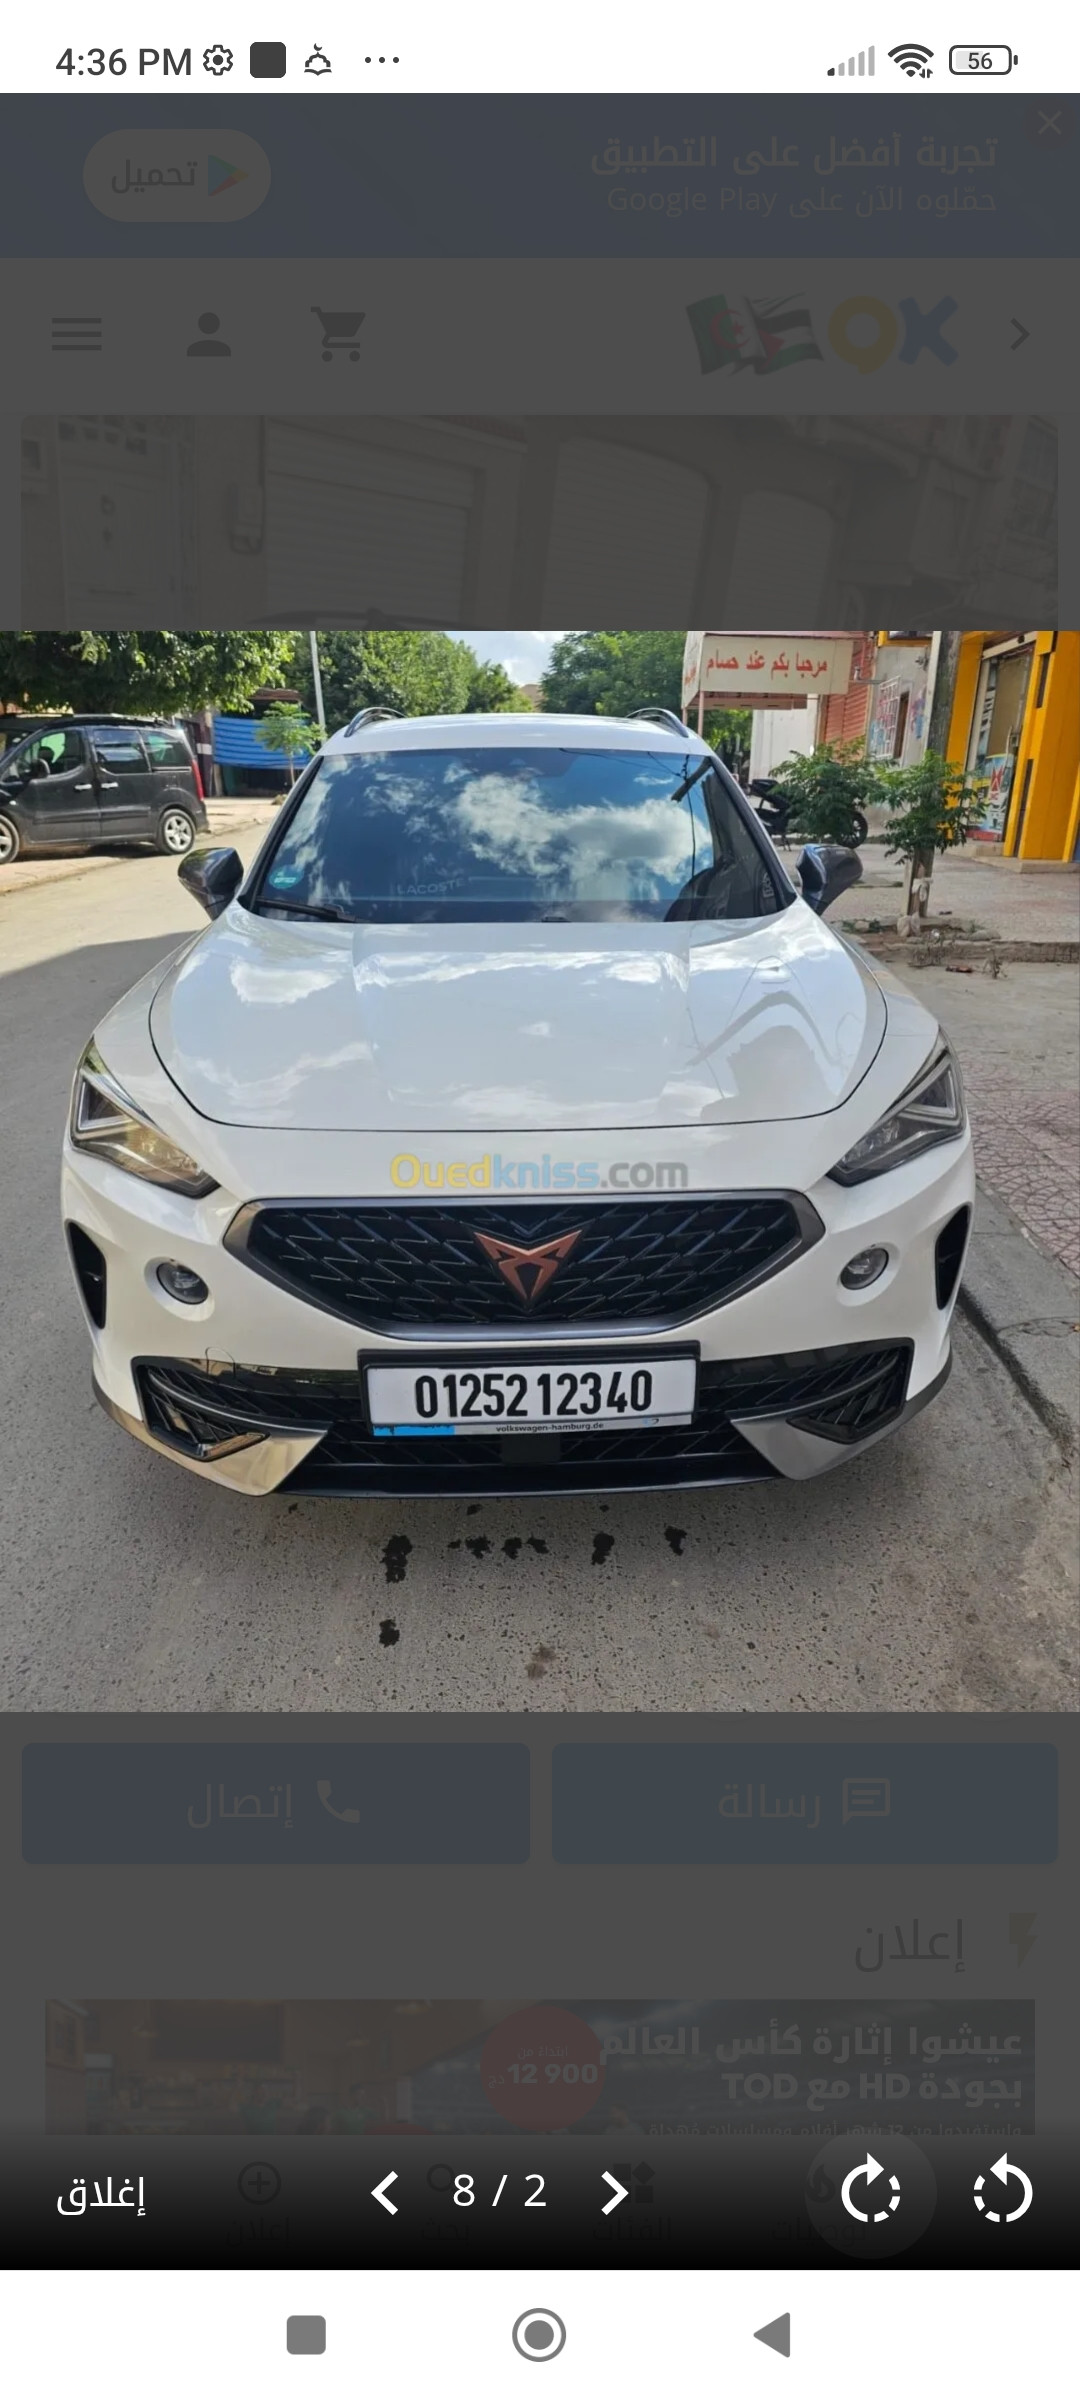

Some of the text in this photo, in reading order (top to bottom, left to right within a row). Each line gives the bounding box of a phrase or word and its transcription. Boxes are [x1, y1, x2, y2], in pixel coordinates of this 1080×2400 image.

[56, 47, 192, 75] 4:36 PM
[968, 52, 992, 69] 56
[591, 132, 999, 175] تجربة أفضل على التطبيق
[111, 159, 198, 194] تحميل
[608, 187, 707, 218] Google
[719, 187, 778, 218] Play
[789, 187, 844, 218] على
[856, 184, 903, 218] الآن
[707, 650, 739, 680] حسام
[746, 649, 765, 671] عند
[771, 652, 790, 680] بكم
[796, 652, 828, 679] مرحبا
[496, 1421, 605, 1434] volkswagen-hamburg.de
[187, 1783, 294, 1829] إتصال
[717, 1783, 821, 1829] رسالة
[855, 1918, 966, 1973] إعلان
[599, 2018, 1022, 2065] عيشوا إثارة كأس العالم
[721, 2073, 1022, 2111] بجودة HD مع TOD
[56, 2176, 146, 2217] إغلاق
[453, 2174, 475, 2207] 8
[525, 2174, 547, 2207] 2
